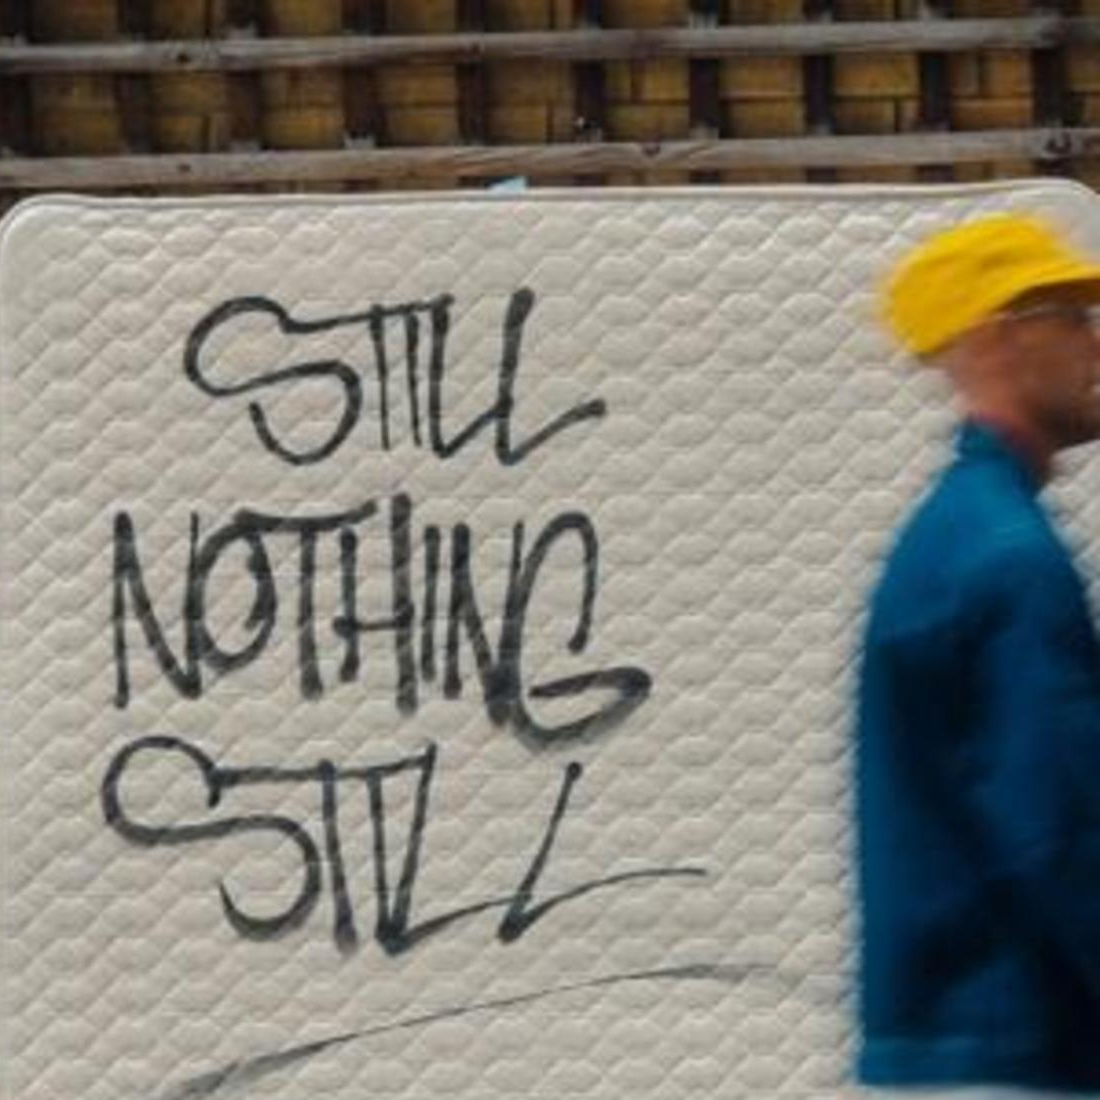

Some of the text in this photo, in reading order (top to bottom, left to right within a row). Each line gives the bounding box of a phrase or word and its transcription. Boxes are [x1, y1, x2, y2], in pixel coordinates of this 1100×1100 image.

[182, 287, 608, 467] STILL
[109, 492, 654, 752] NOTHING
[100, 735, 708, 957] STILL
